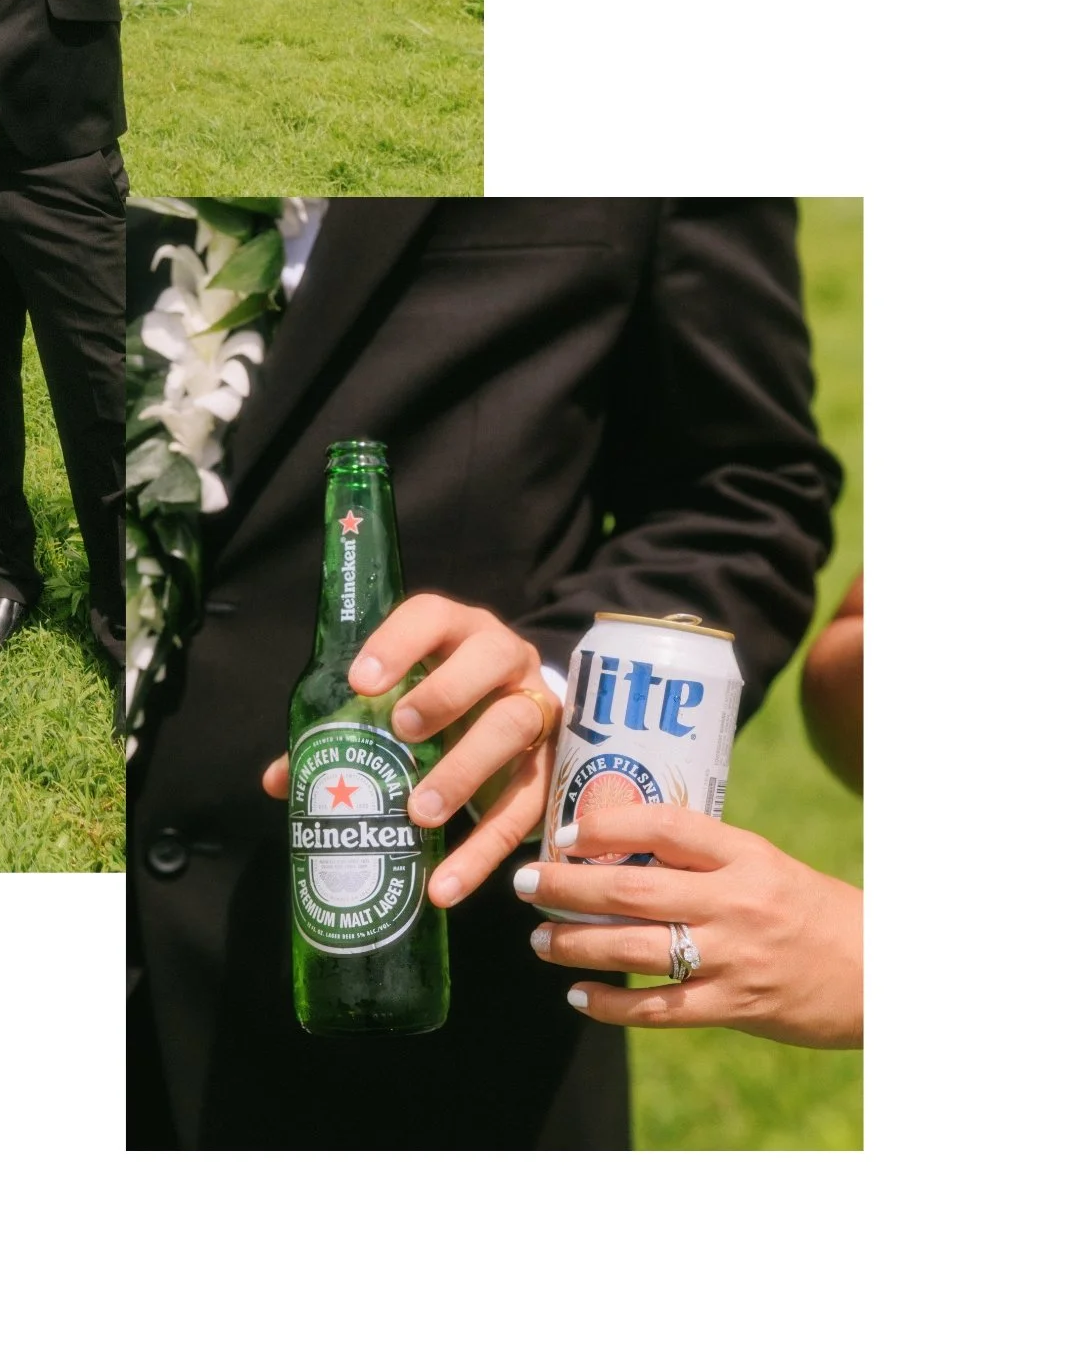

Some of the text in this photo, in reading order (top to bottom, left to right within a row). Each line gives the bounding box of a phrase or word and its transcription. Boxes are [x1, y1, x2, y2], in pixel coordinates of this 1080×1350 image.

[340, 539, 356, 622] Heineken
[566, 649, 704, 745] Lite
[296, 746, 339, 802] HEINEKEN
[345, 747, 404, 800] ORIGINAL
[568, 757, 660, 804] A FINE PILSNE
[291, 821, 415, 848] Heineken
[298, 879, 335, 927] PREMIUM
[339, 912, 373, 929] MALT
[373, 877, 405, 918] LAGER
